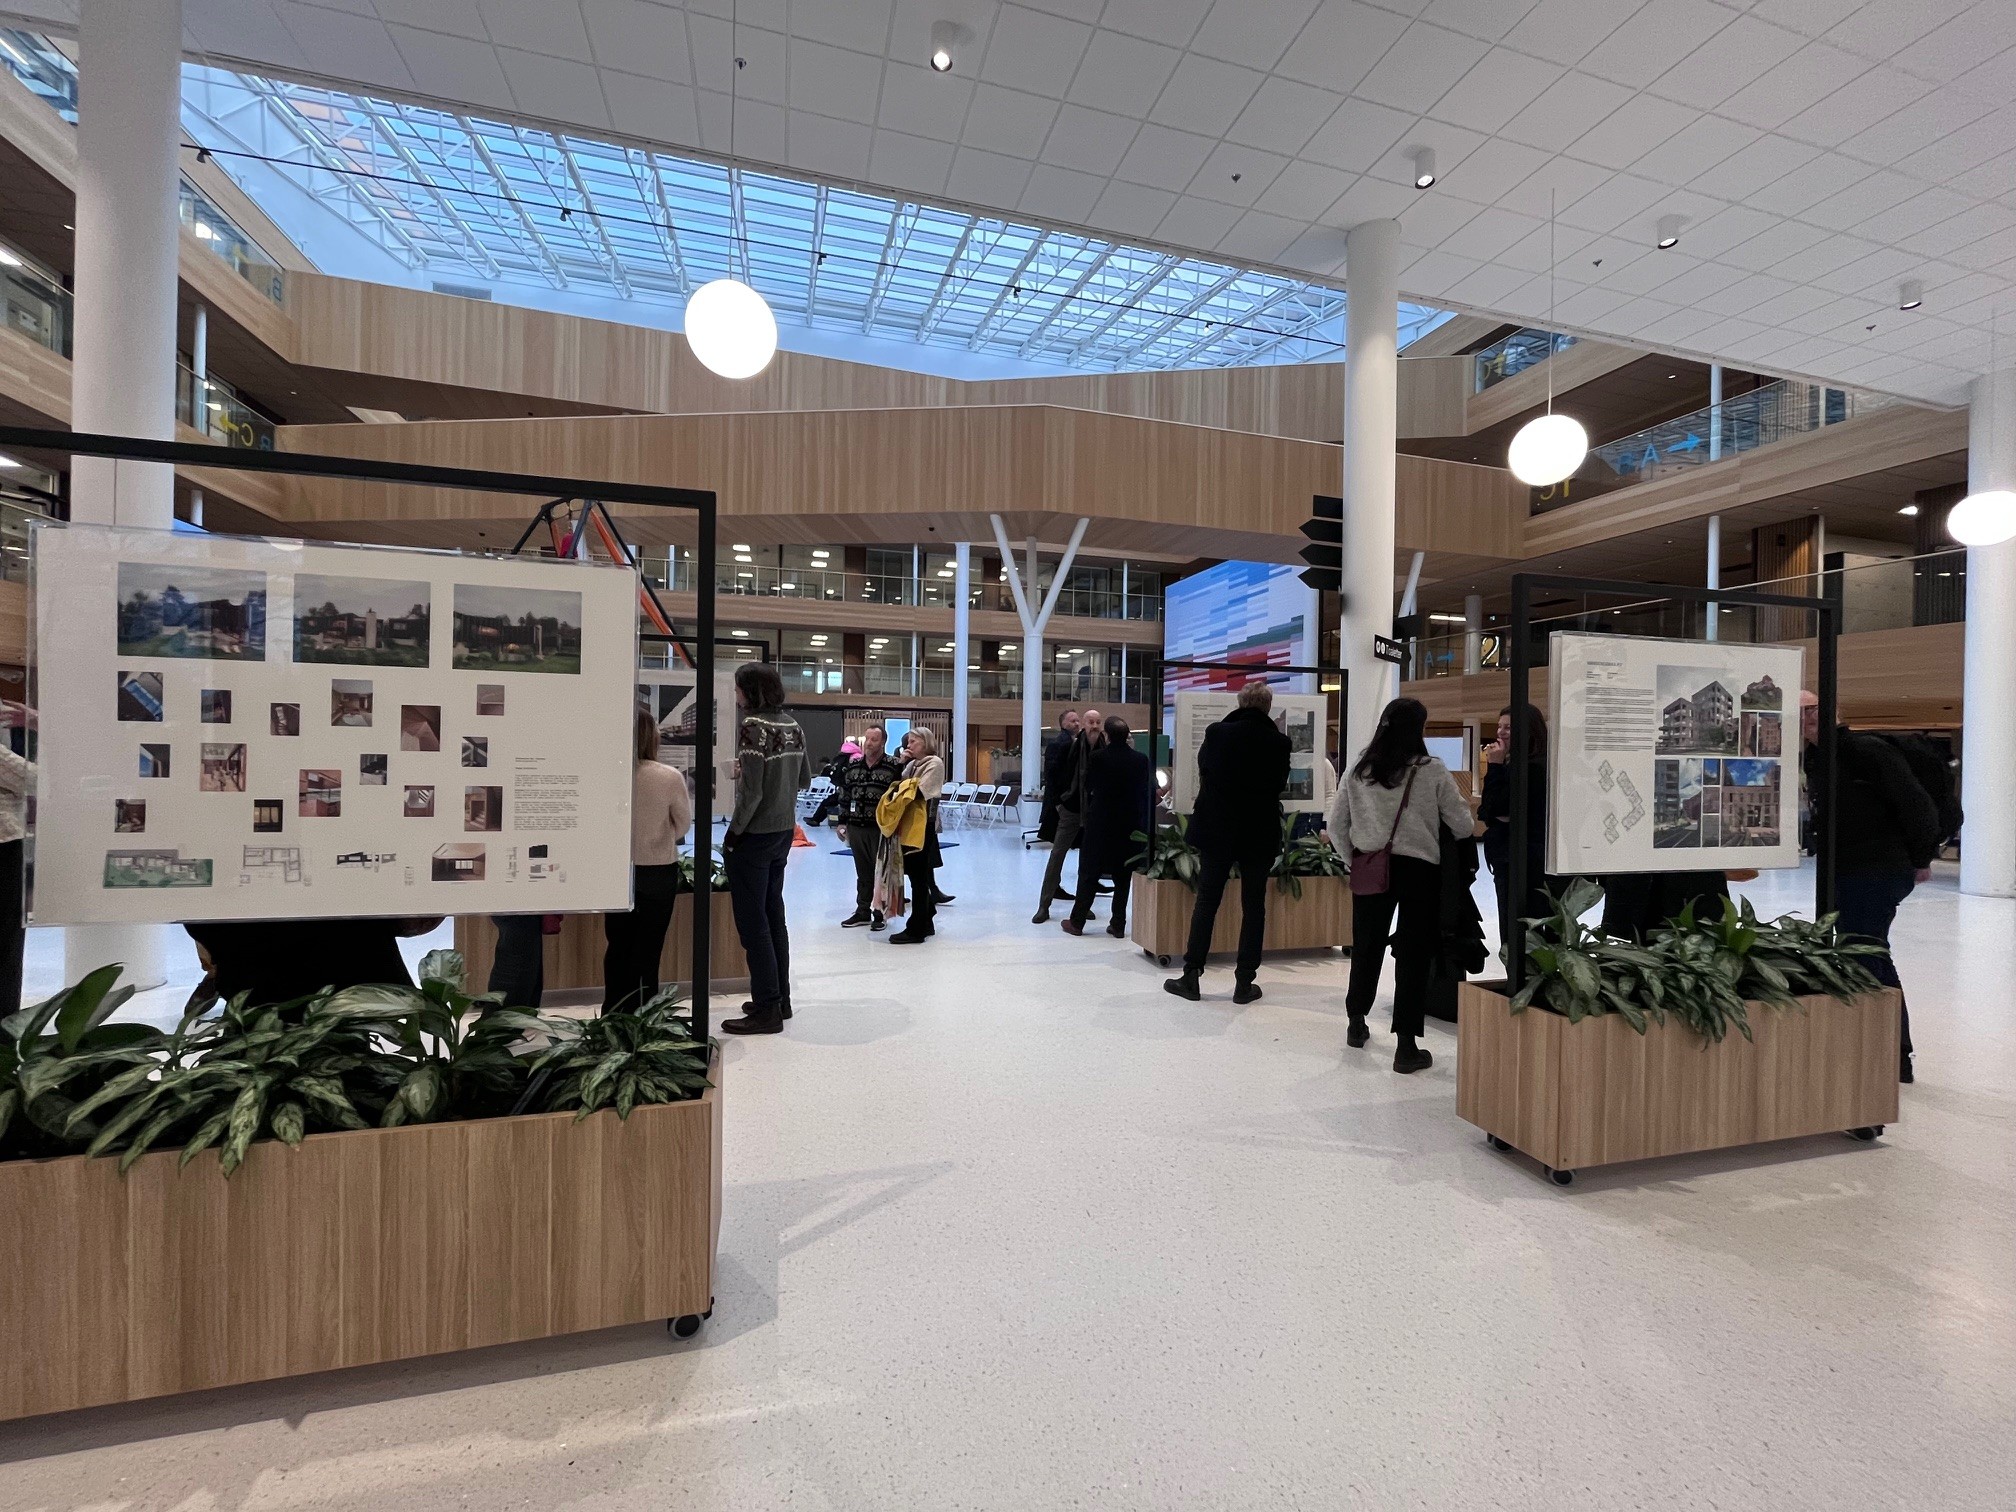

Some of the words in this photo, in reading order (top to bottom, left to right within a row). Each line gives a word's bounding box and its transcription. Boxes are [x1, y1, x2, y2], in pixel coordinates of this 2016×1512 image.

[1640, 443, 1661, 469] A
[1424, 650, 1434, 668] A
[1481, 634, 1500, 667] 2
